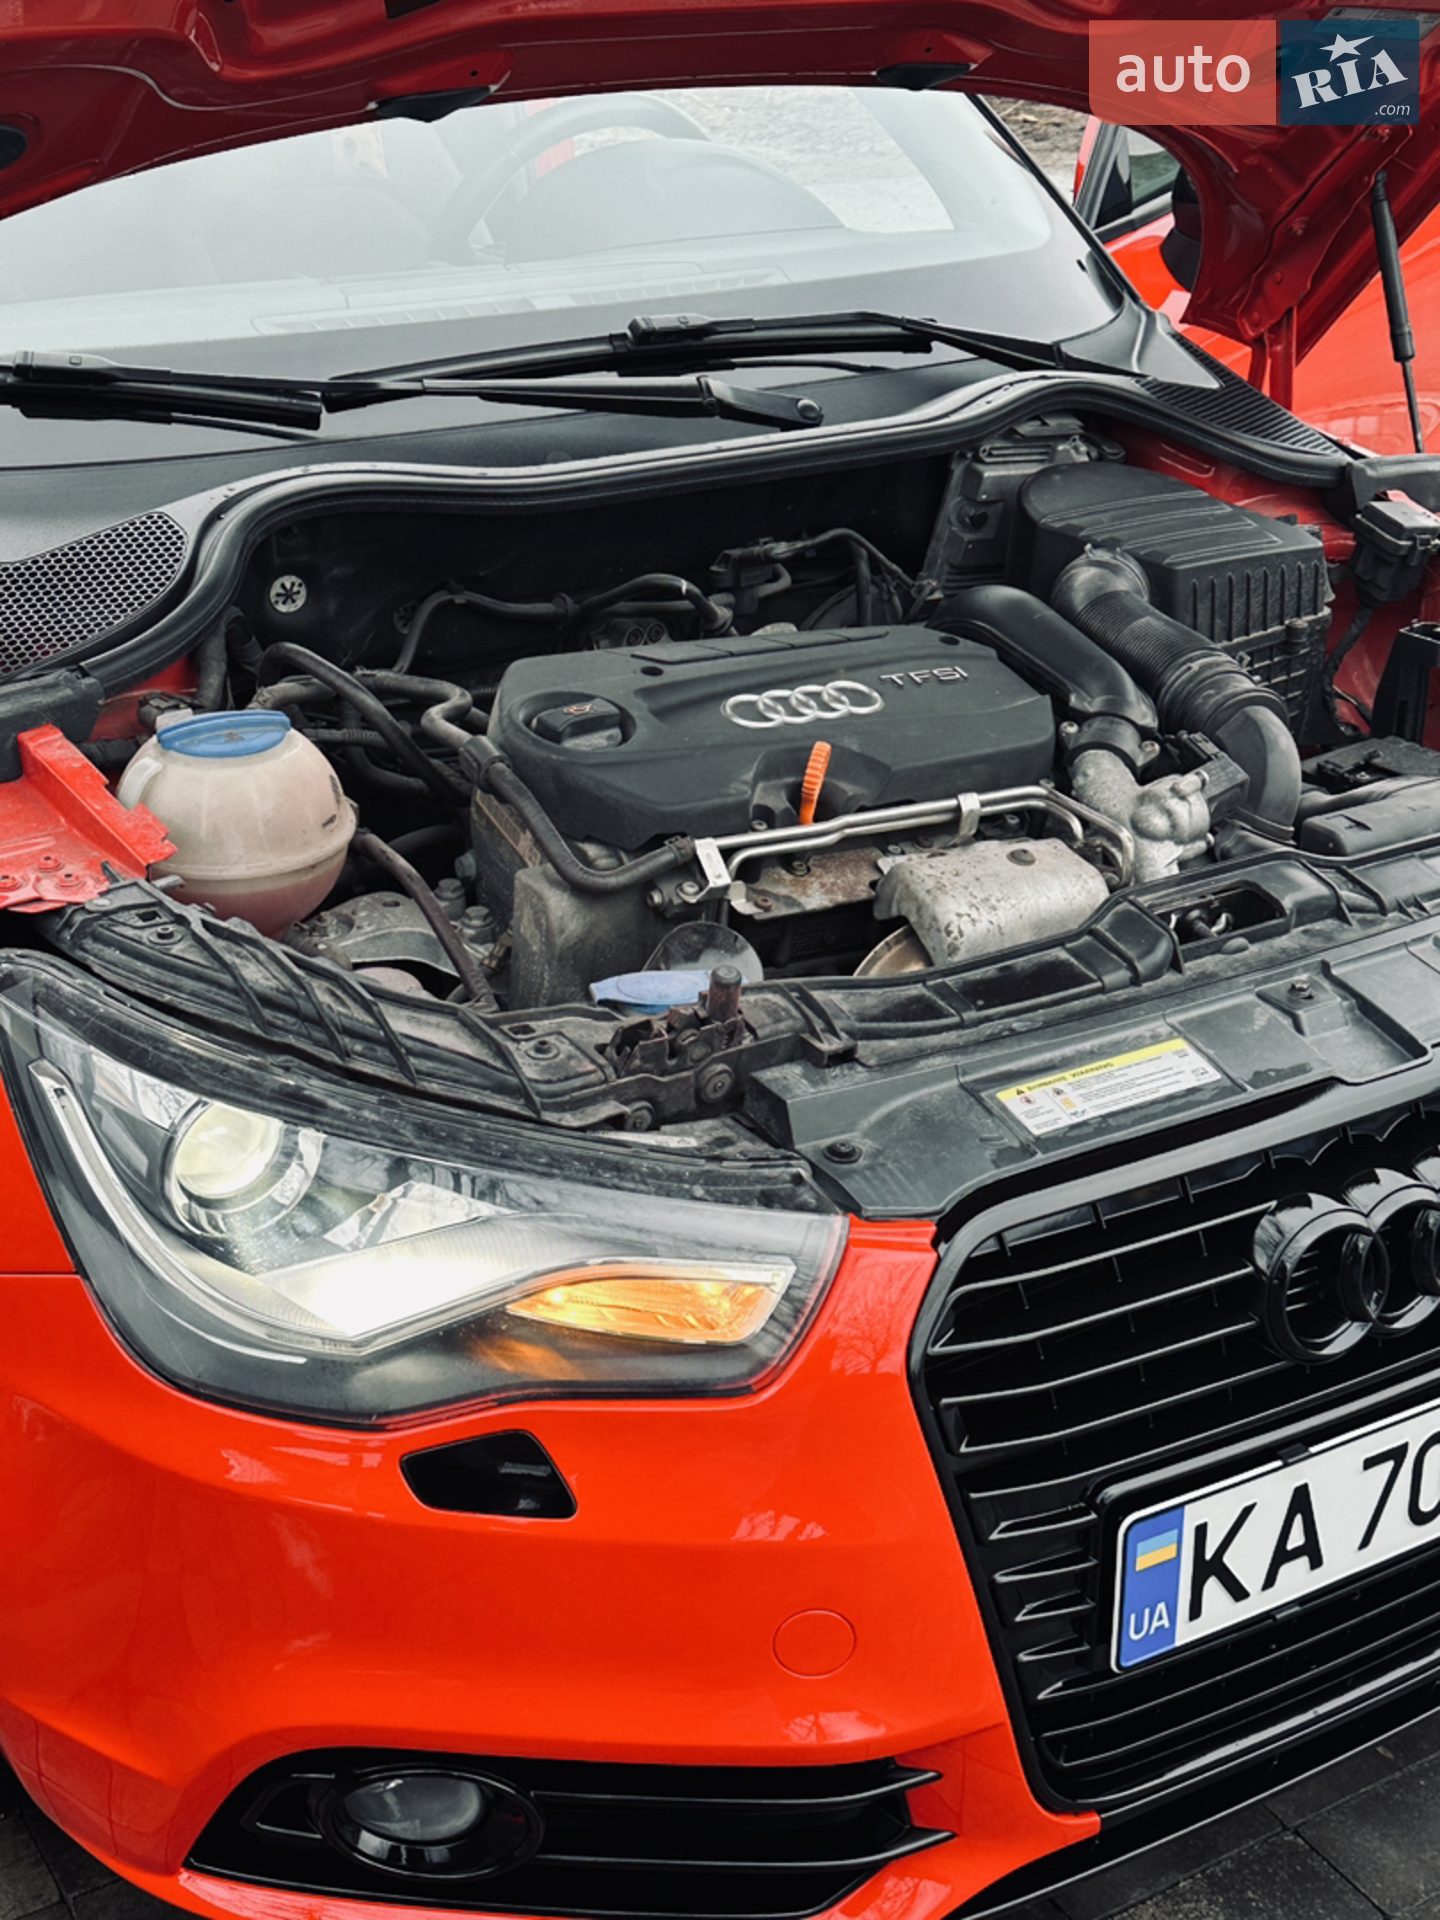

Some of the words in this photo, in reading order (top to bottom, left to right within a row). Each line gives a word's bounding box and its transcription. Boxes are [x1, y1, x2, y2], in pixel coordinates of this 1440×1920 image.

[879, 666, 969, 686] TFSI
[1189, 1482, 1323, 1622] KA
[1129, 1602, 1170, 1640] UA
